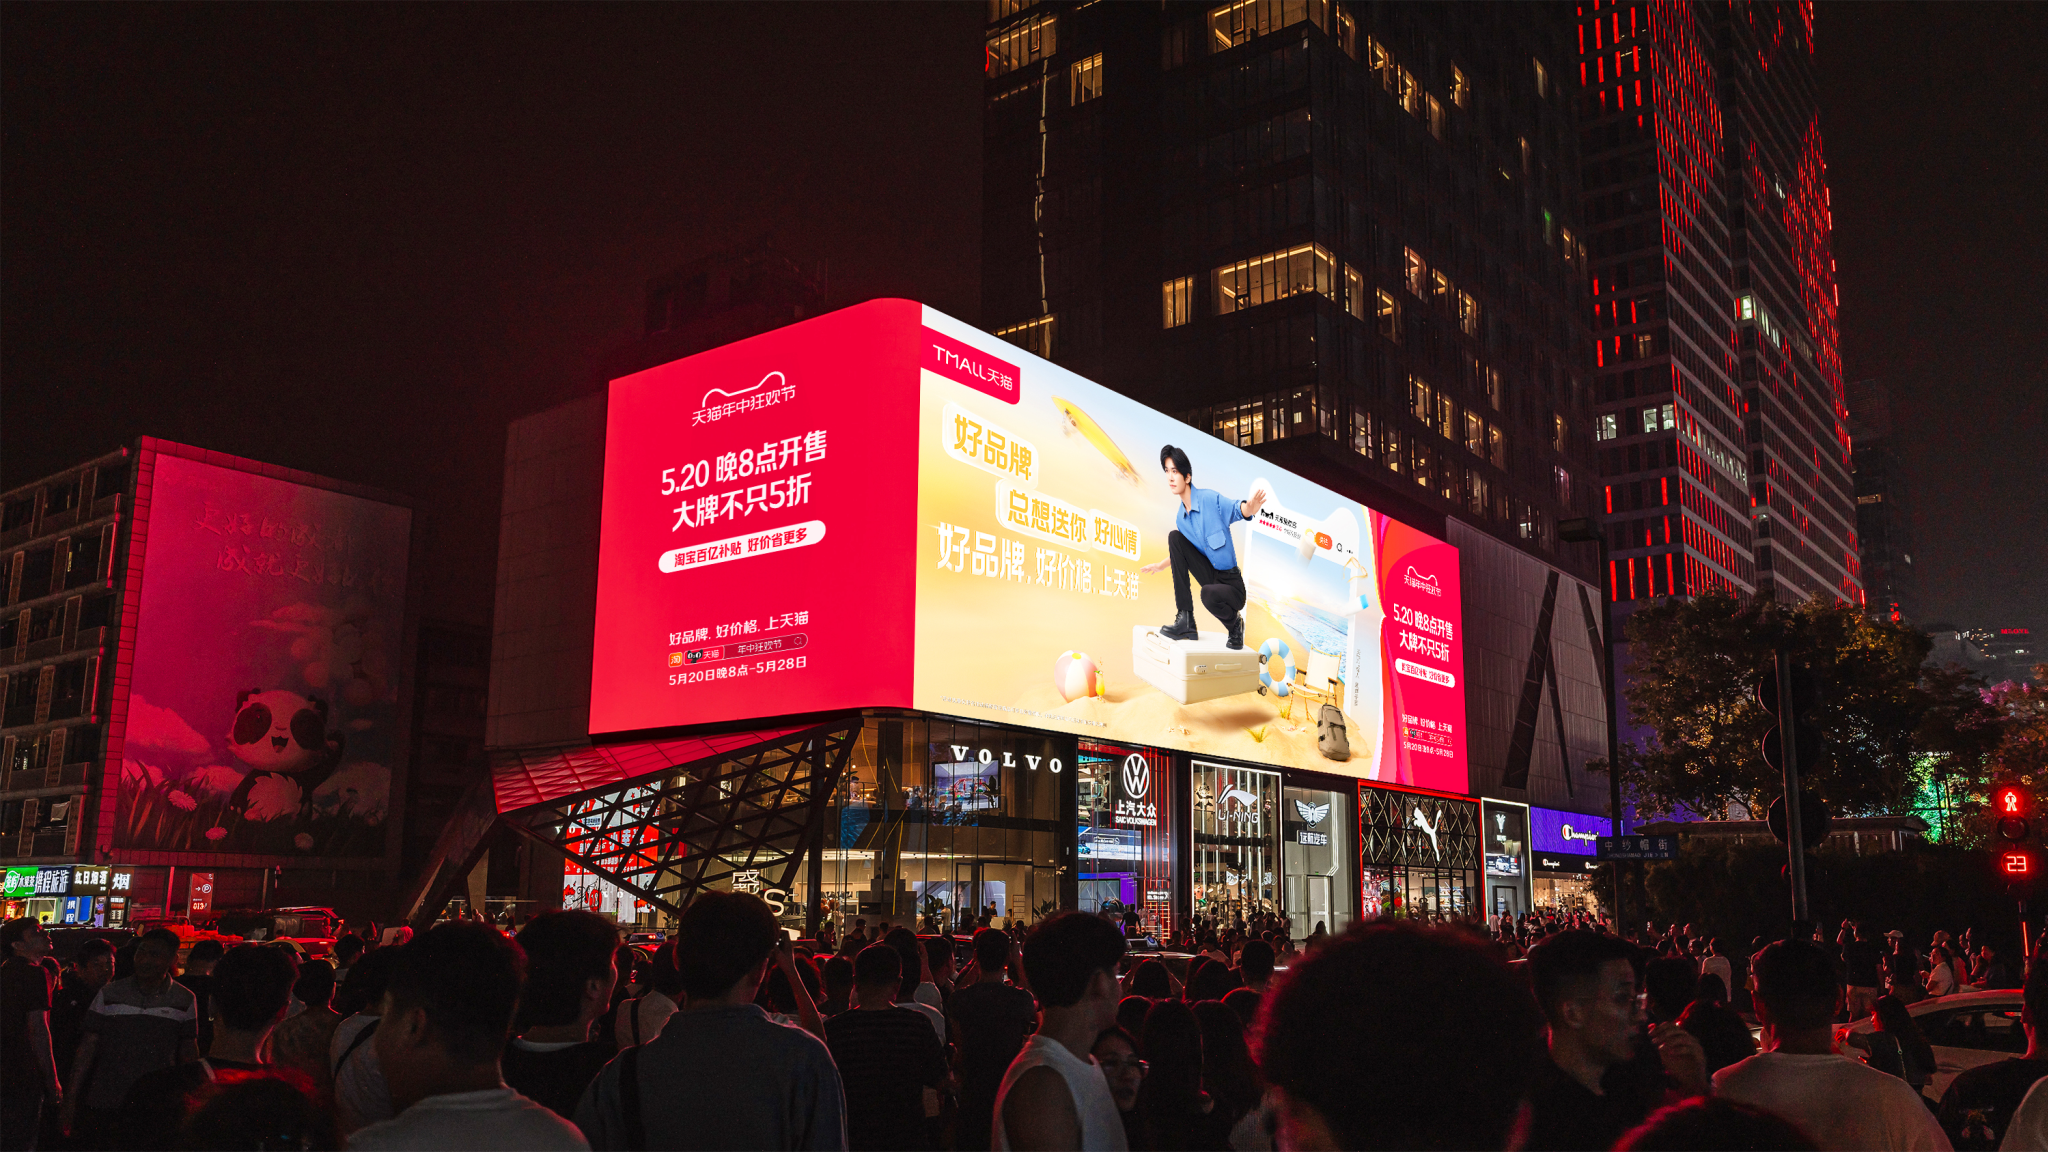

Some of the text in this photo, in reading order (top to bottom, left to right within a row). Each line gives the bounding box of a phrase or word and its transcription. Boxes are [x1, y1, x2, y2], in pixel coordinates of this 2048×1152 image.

[691, 384, 796, 427] 天猫年中狂欢节
[661, 429, 828, 496] 5.20 晚8点开售
[954, 413, 1032, 481] 好品牌
[671, 472, 812, 533] 大牌不只5折
[1007, 488, 1138, 556] 总想送你 好心情
[673, 527, 808, 569] 淘宝百亿补贴 好价省更多
[1393, 603, 1454, 641] 5.20 晚8点开售
[703, 649, 720, 660] 天猫
[737, 639, 782, 654] 年中狂欢节
[1398, 629, 1450, 663] 大牌不只5折
[950, 745, 1063, 774] VOLVO
[1115, 799, 1157, 818] 上汽大众
[1217, 809, 1260, 824] LI-NING
[2006, 855, 2027, 872] 23
[34, 869, 70, 893] 携程旅游
[111, 872, 131, 890] 烟
